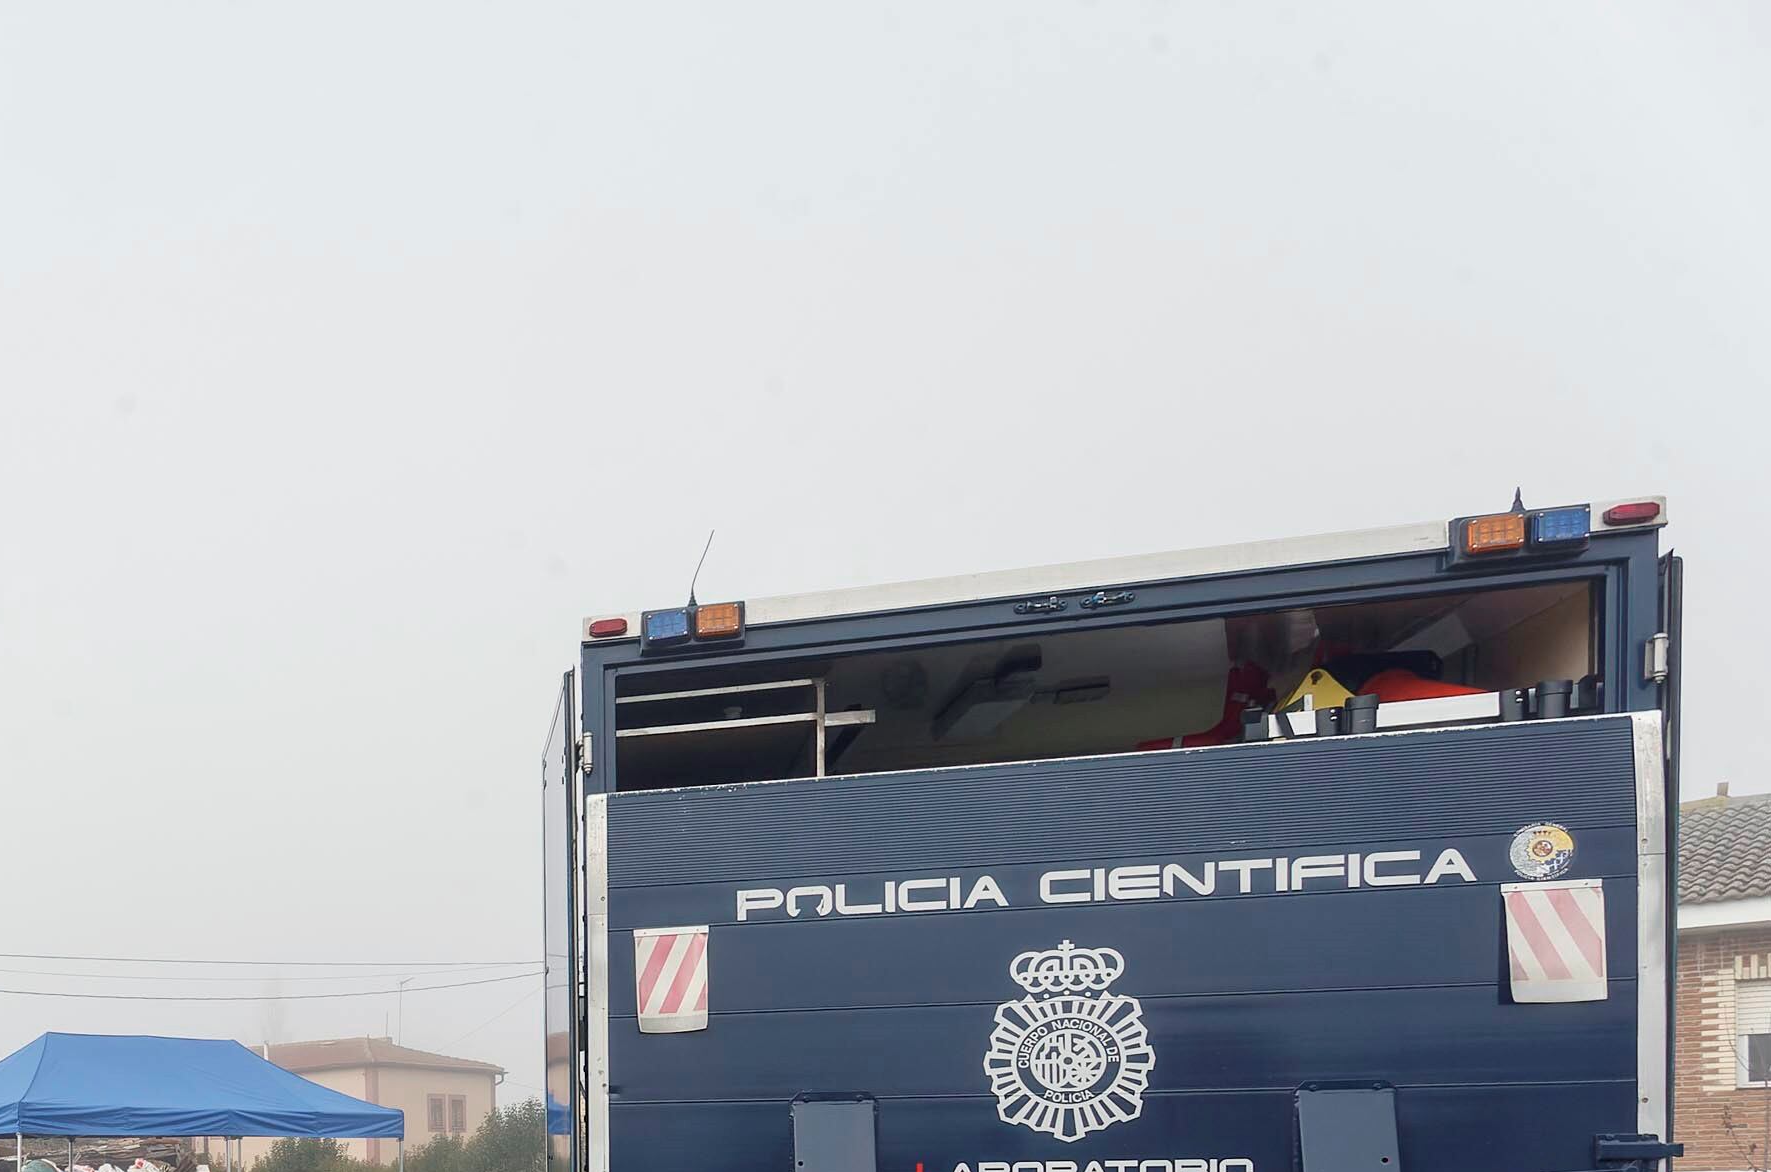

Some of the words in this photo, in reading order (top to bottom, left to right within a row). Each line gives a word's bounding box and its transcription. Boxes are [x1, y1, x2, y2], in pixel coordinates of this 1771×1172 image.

[736, 875, 1009, 921] POLICIA
[1039, 848, 1477, 904] CIENTIFICA
[1017, 1025, 1048, 1069] CUERPO
[1051, 1018, 1112, 1047] NACIONAL
[1106, 1046, 1120, 1063] DE
[1043, 1089, 1096, 1104] POLICIA
